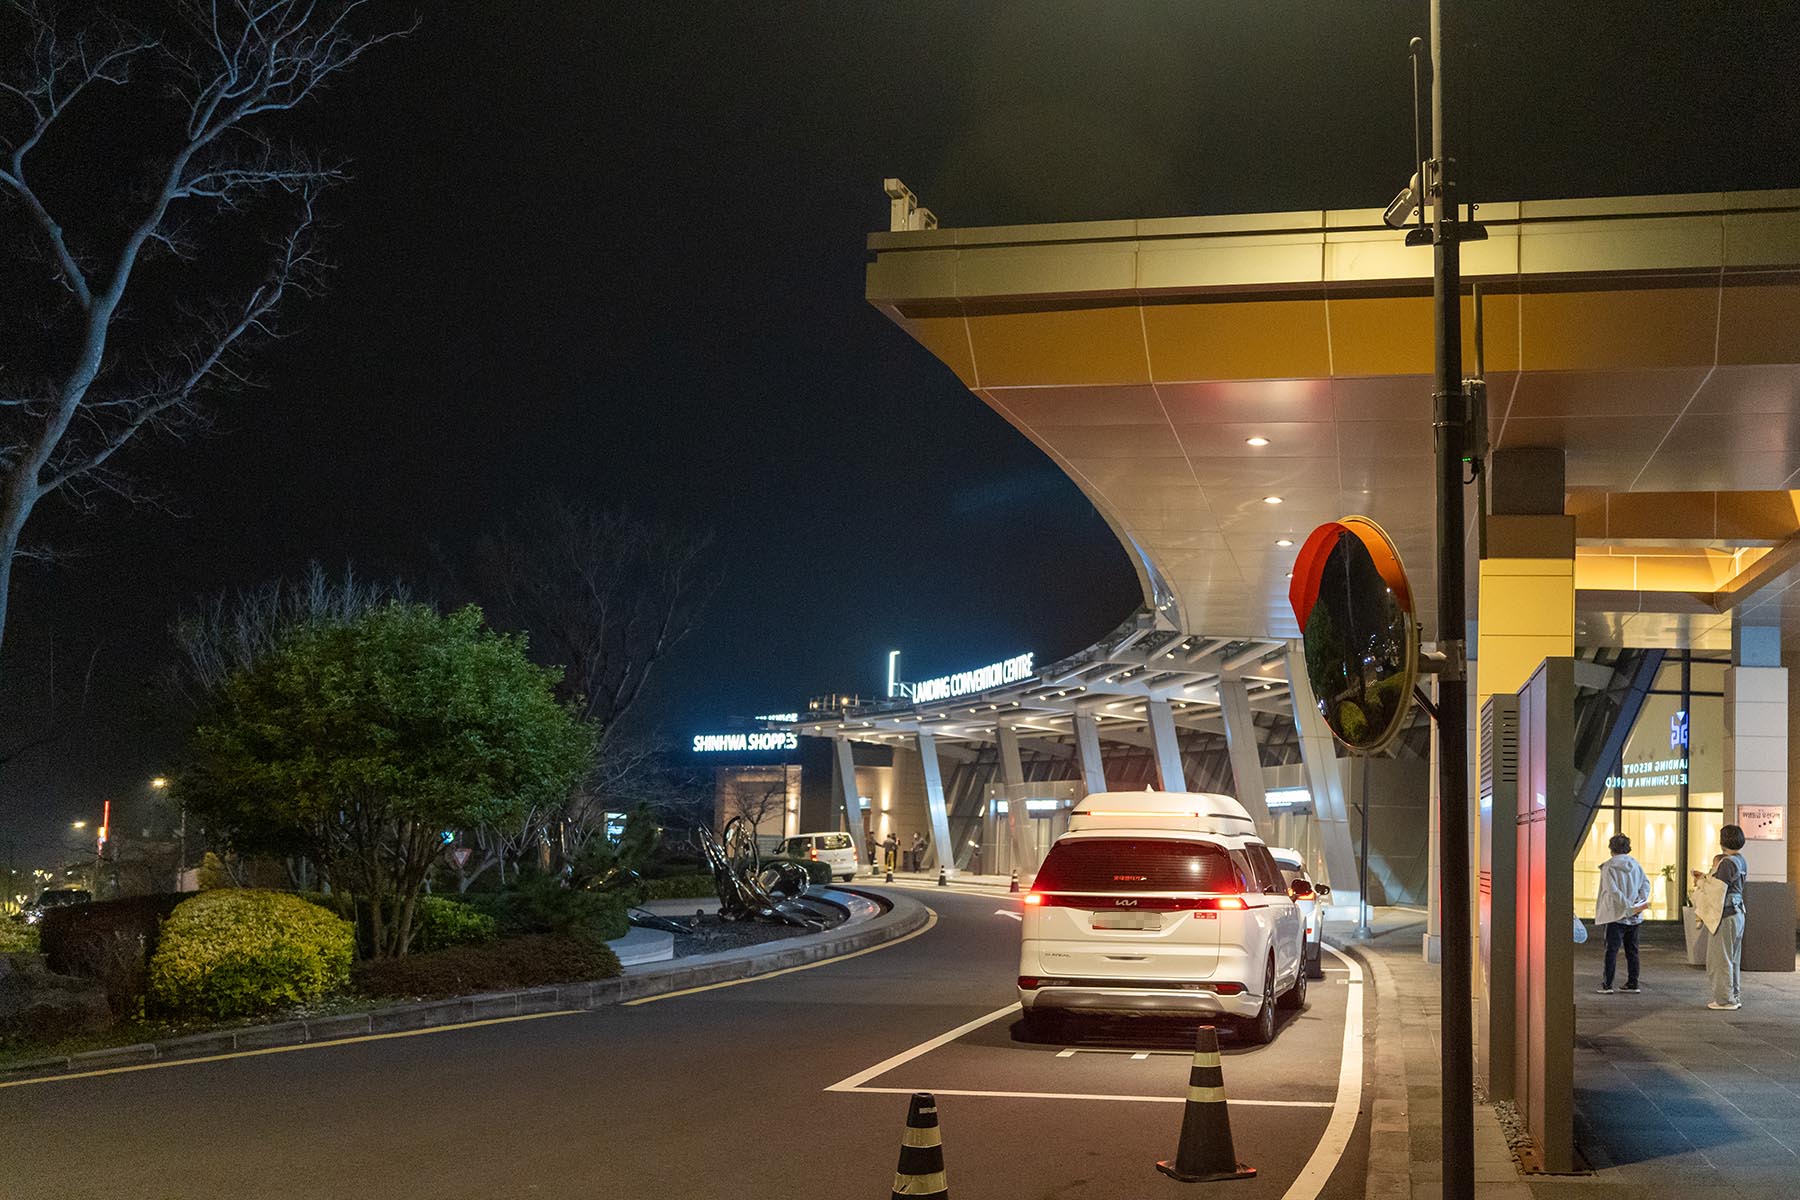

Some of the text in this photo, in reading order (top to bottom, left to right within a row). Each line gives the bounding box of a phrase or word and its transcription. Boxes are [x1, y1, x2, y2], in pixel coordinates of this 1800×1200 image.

[912, 652, 1034, 704] LANDING CONVENTION CENTRE
[692, 733, 747, 752] SHINHWA
